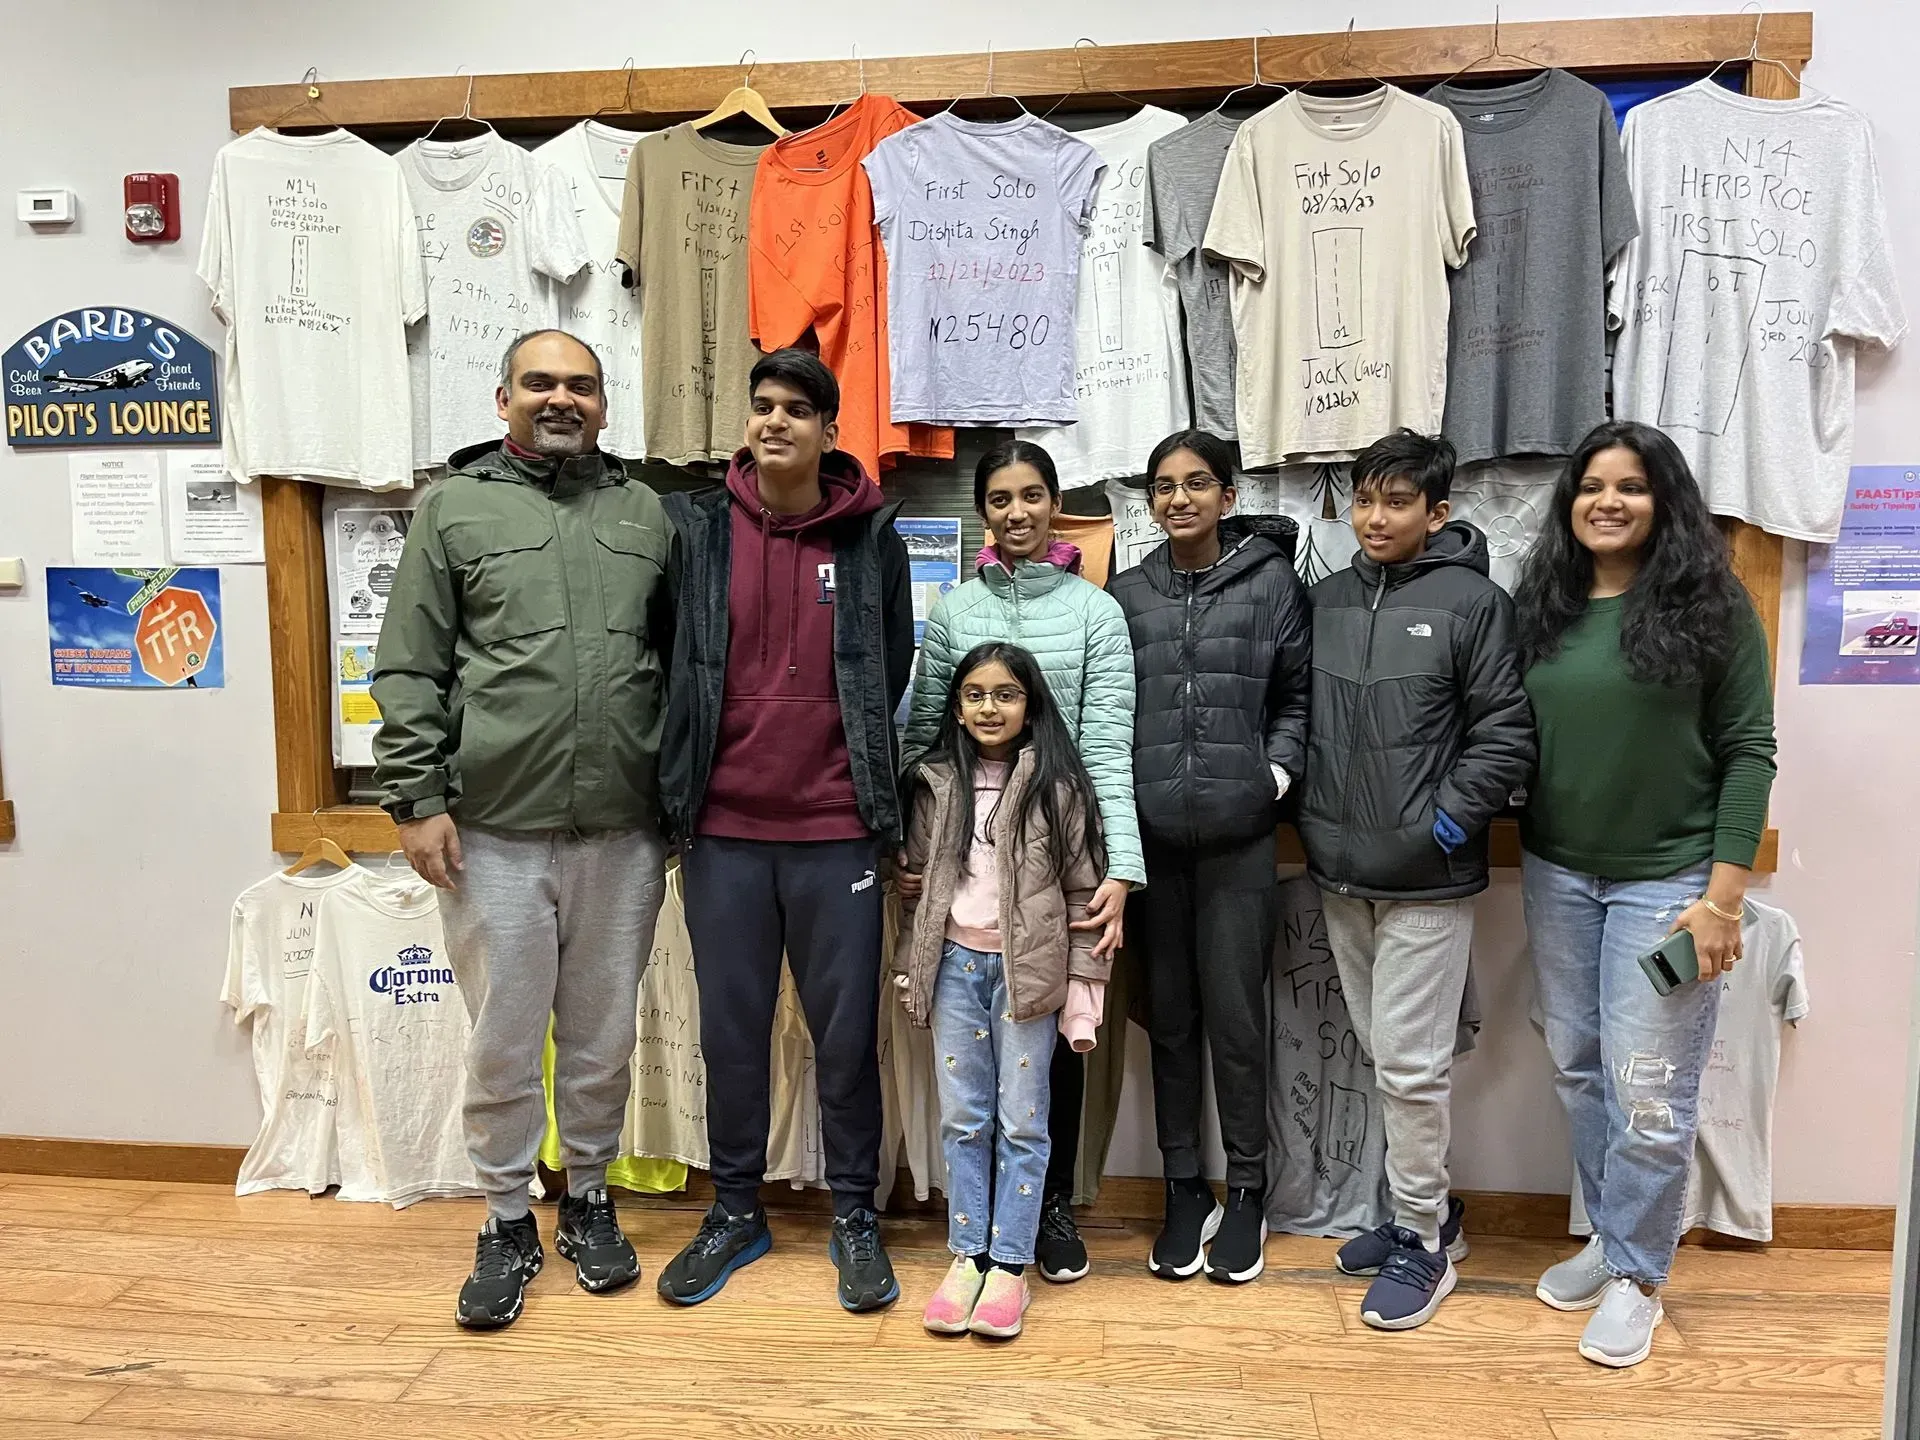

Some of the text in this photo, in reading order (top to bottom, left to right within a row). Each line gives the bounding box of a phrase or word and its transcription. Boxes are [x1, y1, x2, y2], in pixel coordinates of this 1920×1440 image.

[1723, 137, 1805, 177] N14
[286, 178, 316, 195] N14
[682, 171, 741, 200] First
[924, 175, 1036, 201] First Solo
[1294, 159, 1381, 190] First Solo
[268, 195, 328, 210] First Solo
[1302, 187, 1375, 215] 08/22/23
[1681, 164, 1813, 216] HERB ROE
[270, 218, 342, 234] Greg Skinner
[685, 213, 722, 239] Greg
[908, 217, 1039, 255] Dishita Singh
[1660, 205, 1817, 269] FIRST SOLO
[928, 256, 1045, 290] 12/21/2023
[1765, 300, 1815, 331] JULY
[22, 309, 180, 369] BARB'S
[929, 311, 1050, 350] N25480
[1333, 325, 1350, 340] 01
[10, 369, 39, 383] Cold
[160, 361, 192, 379] Great
[1302, 357, 1348, 389] Jack
[10, 384, 42, 397] Beer
[154, 377, 201, 392] Friends
[7, 400, 211, 437] PILOT'S LOUNGE
[144, 610, 205, 664] TFR
[54, 648, 132, 659] CHECK NOTAMS
[55, 663, 72, 672] FLY
[369, 965, 455, 995] Corona
[394, 988, 440, 1005] Extra
